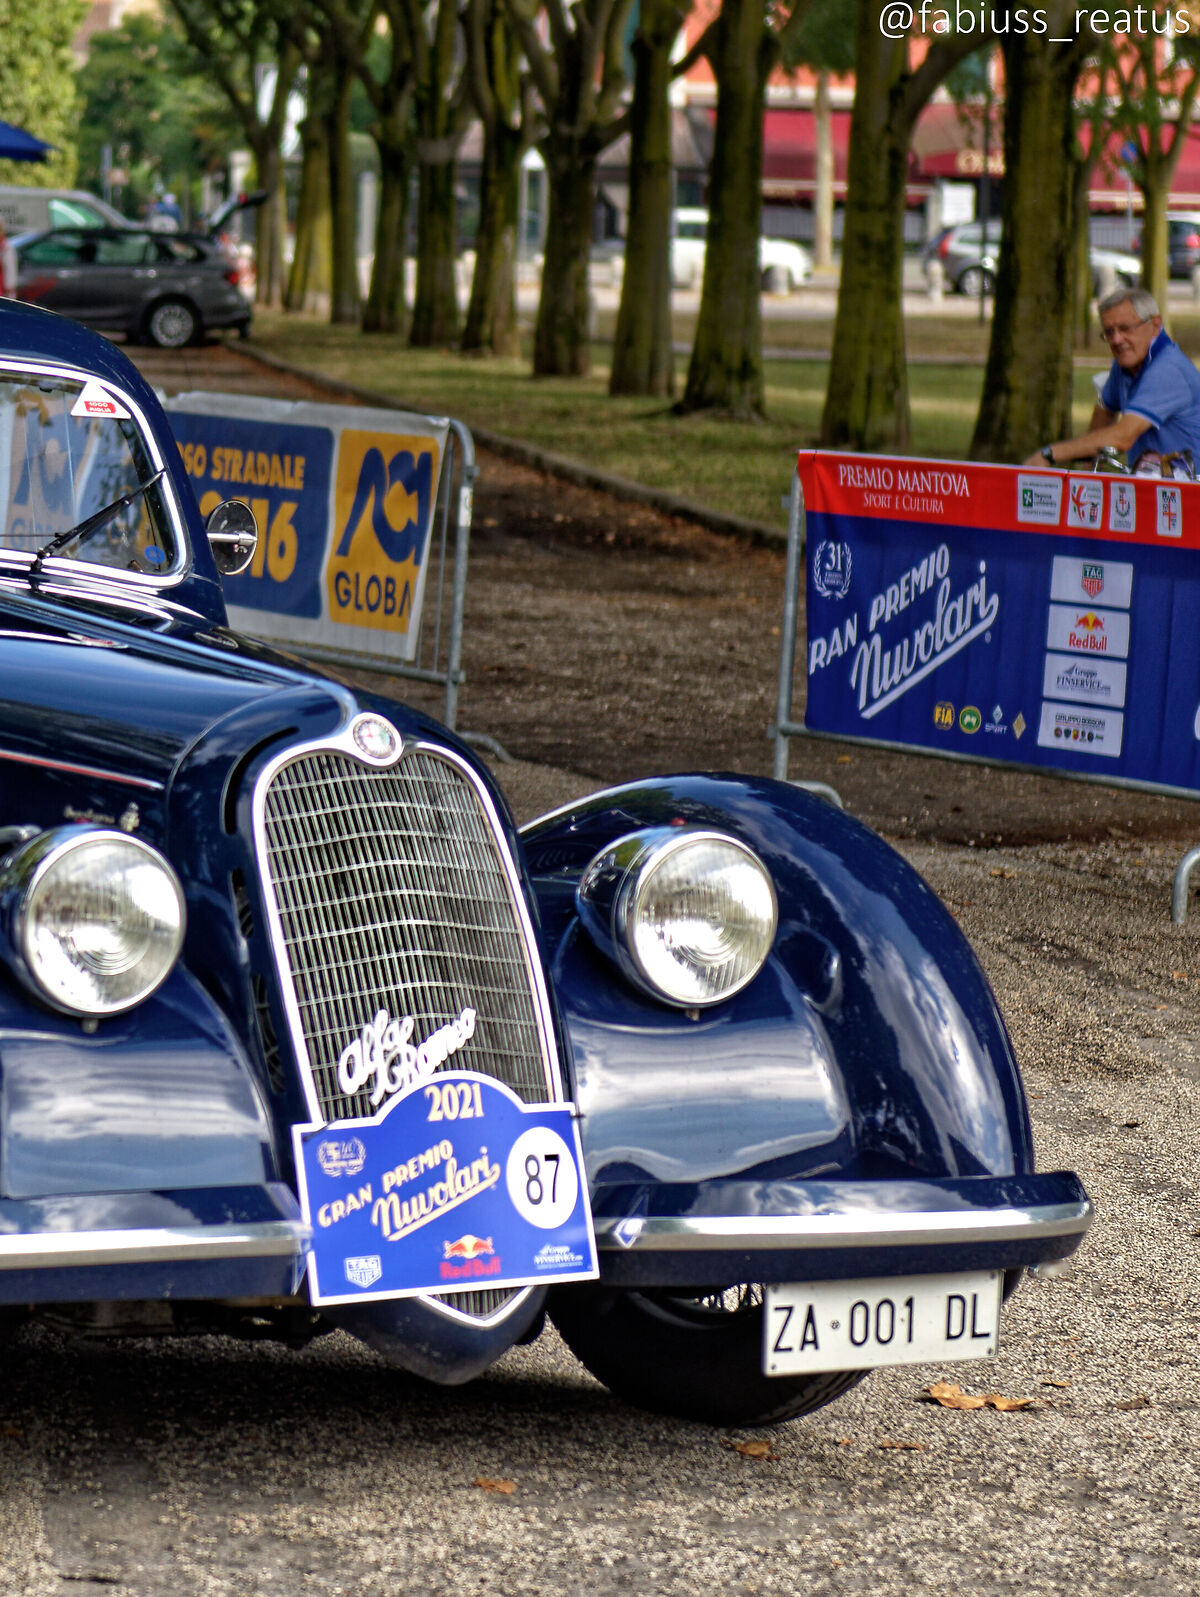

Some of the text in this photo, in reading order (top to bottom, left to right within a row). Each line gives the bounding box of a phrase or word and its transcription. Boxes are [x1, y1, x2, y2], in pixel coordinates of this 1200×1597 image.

[211, 446, 305, 490] STRADALE
[838, 464, 970, 497] PREMIO MANTOVA
[1085, 567, 1103, 579] TAG
[809, 543, 950, 676] RAN PREMIO
[850, 559, 999, 719] Nuvolari
[1069, 632, 1108, 651] Red Bull
[934, 706, 952, 724] FIA
[339, 1009, 414, 1105] Alfa
[424, 1082, 485, 1122] 2021
[318, 1184, 373, 1228] GRAN
[382, 1139, 453, 1194] PREMIO
[370, 1146, 501, 1242] Nuvolari
[525, 1154, 560, 1206] 87
[440, 1256, 501, 1280] Red Bull
[773, 1293, 990, 1353] ZA 001 DL
